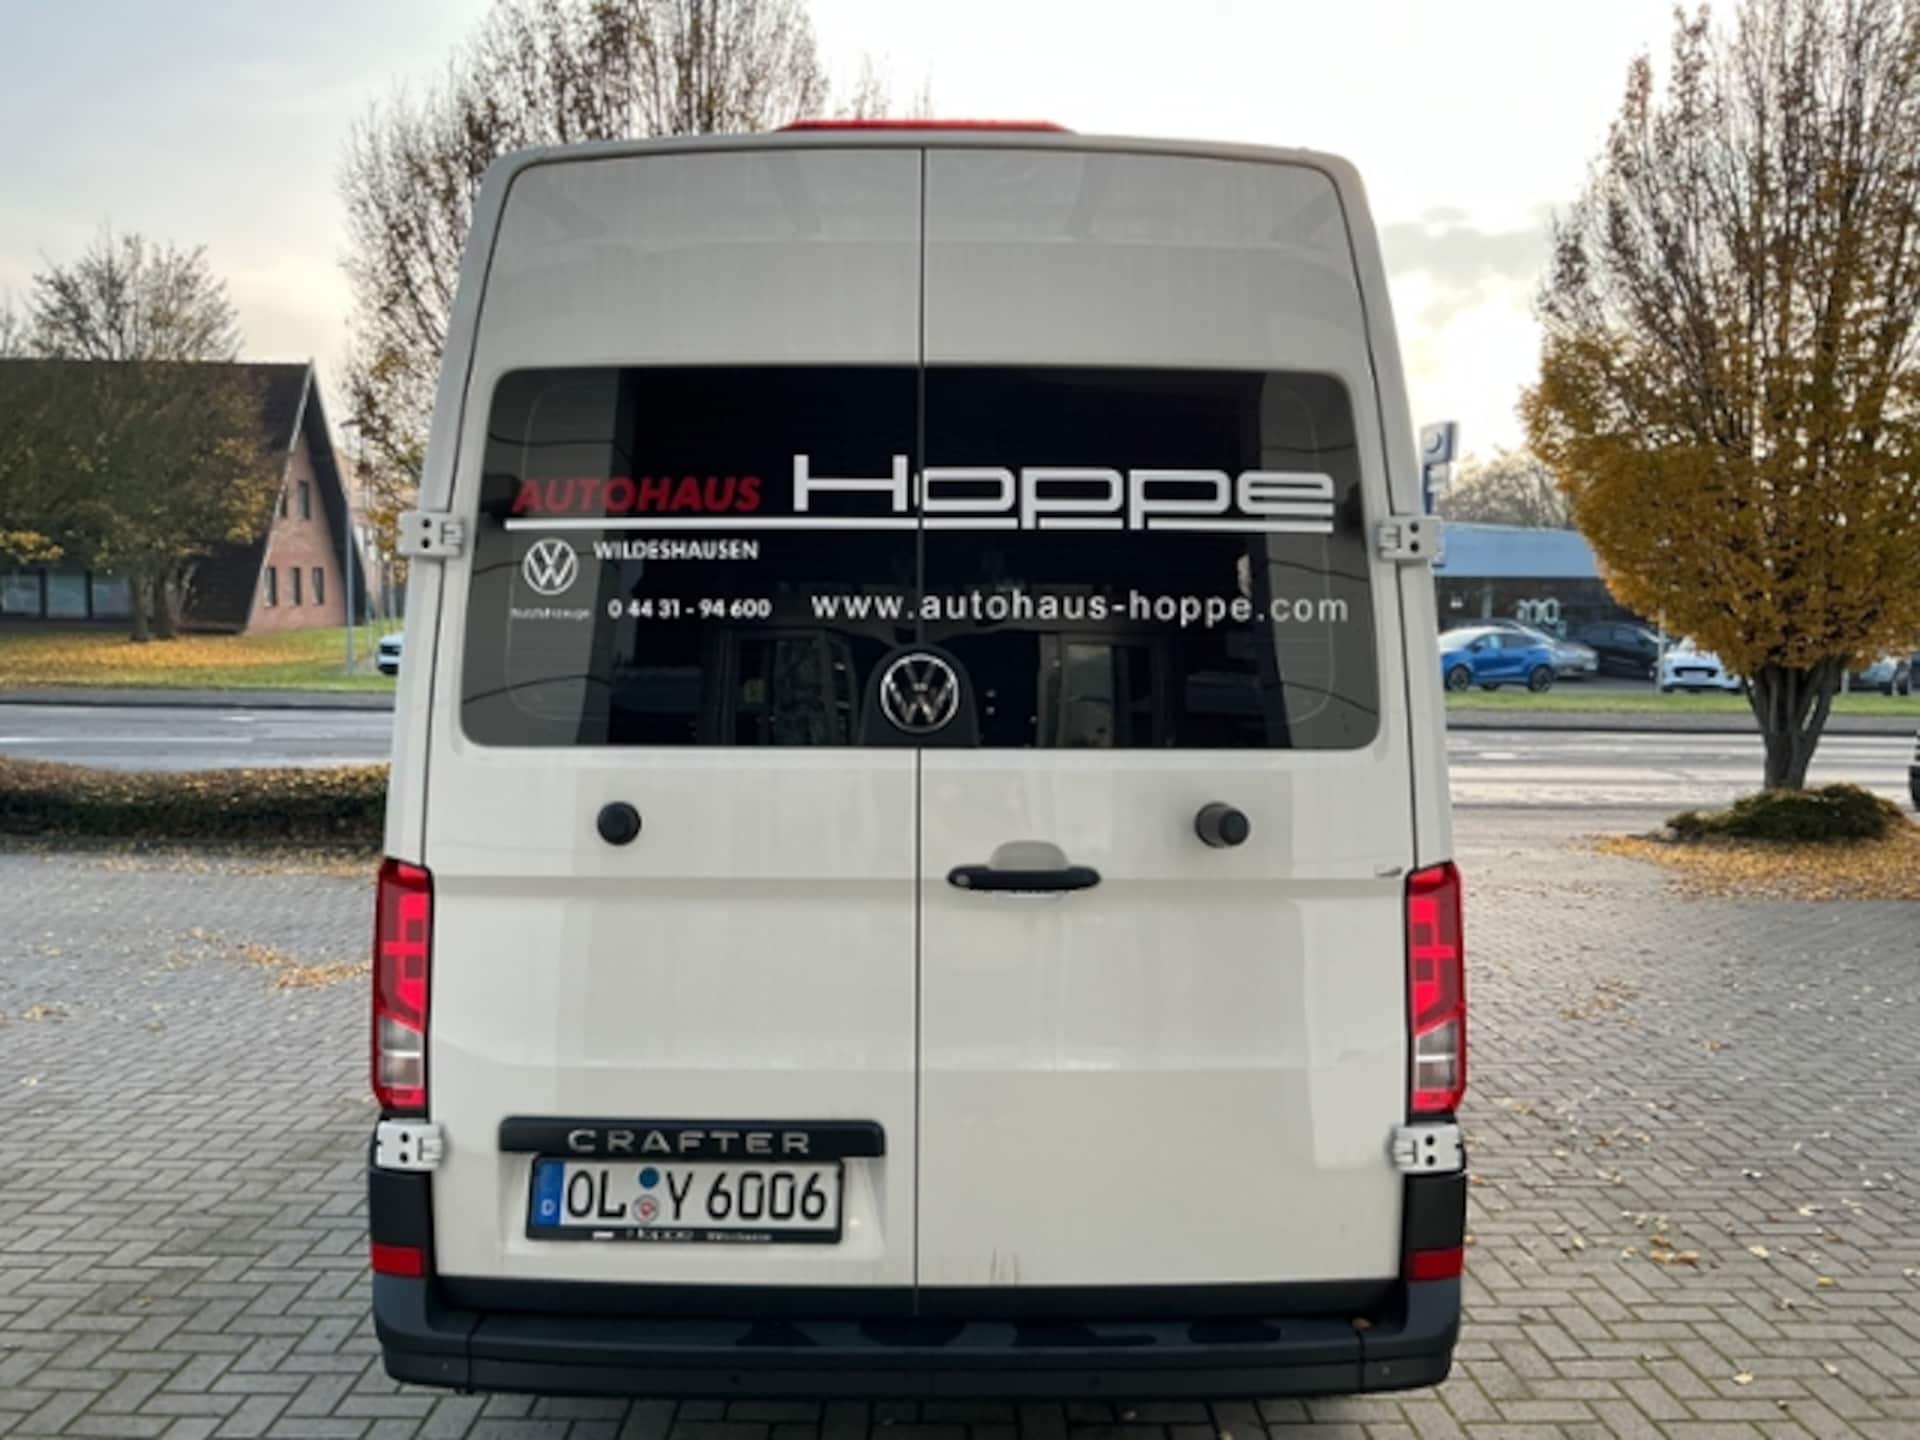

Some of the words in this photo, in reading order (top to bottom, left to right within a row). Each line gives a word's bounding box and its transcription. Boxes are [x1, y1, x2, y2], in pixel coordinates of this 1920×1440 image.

[512, 476, 763, 513] AUTOHAUS
[593, 540, 760, 560] WILDESHAUSEN
[607, 598, 623, 619] 0
[627, 598, 653, 619] 44
[658, 598, 681, 619] 31
[698, 598, 726, 619] 94
[729, 598, 772, 619] 600
[811, 591, 1349, 627] www.autohaus-hoppe.com
[567, 1129, 811, 1155] CRAFTER
[566, 1169, 628, 1221] OL
[666, 1171, 694, 1221] Y
[706, 1171, 828, 1222] 6006
